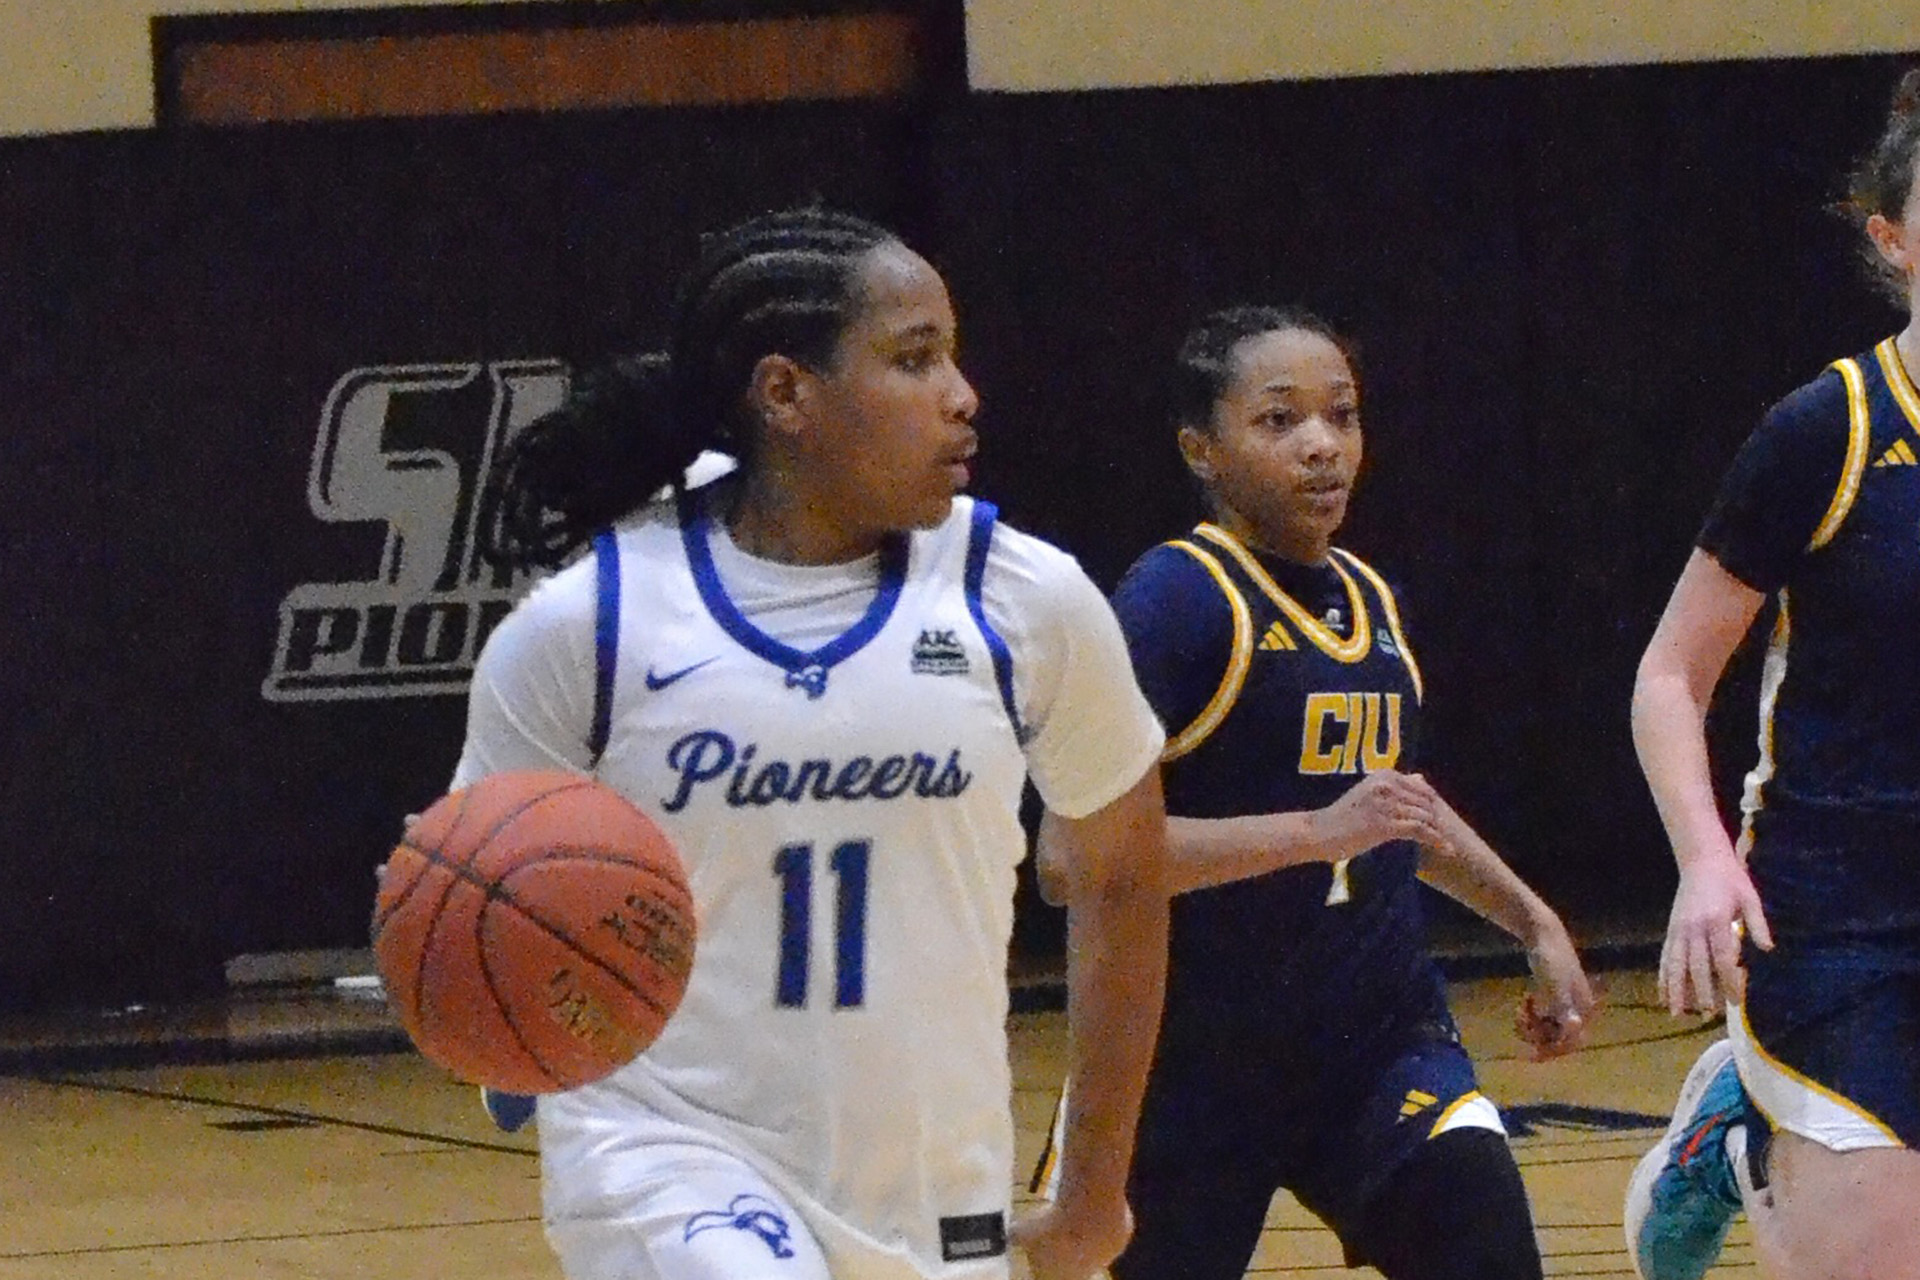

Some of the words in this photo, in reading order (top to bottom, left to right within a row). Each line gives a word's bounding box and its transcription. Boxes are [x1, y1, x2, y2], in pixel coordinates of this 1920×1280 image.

[660, 729, 973, 814] Pioneers
[1298, 692, 1402, 775] CIU
[772, 838, 873, 1012] 11
